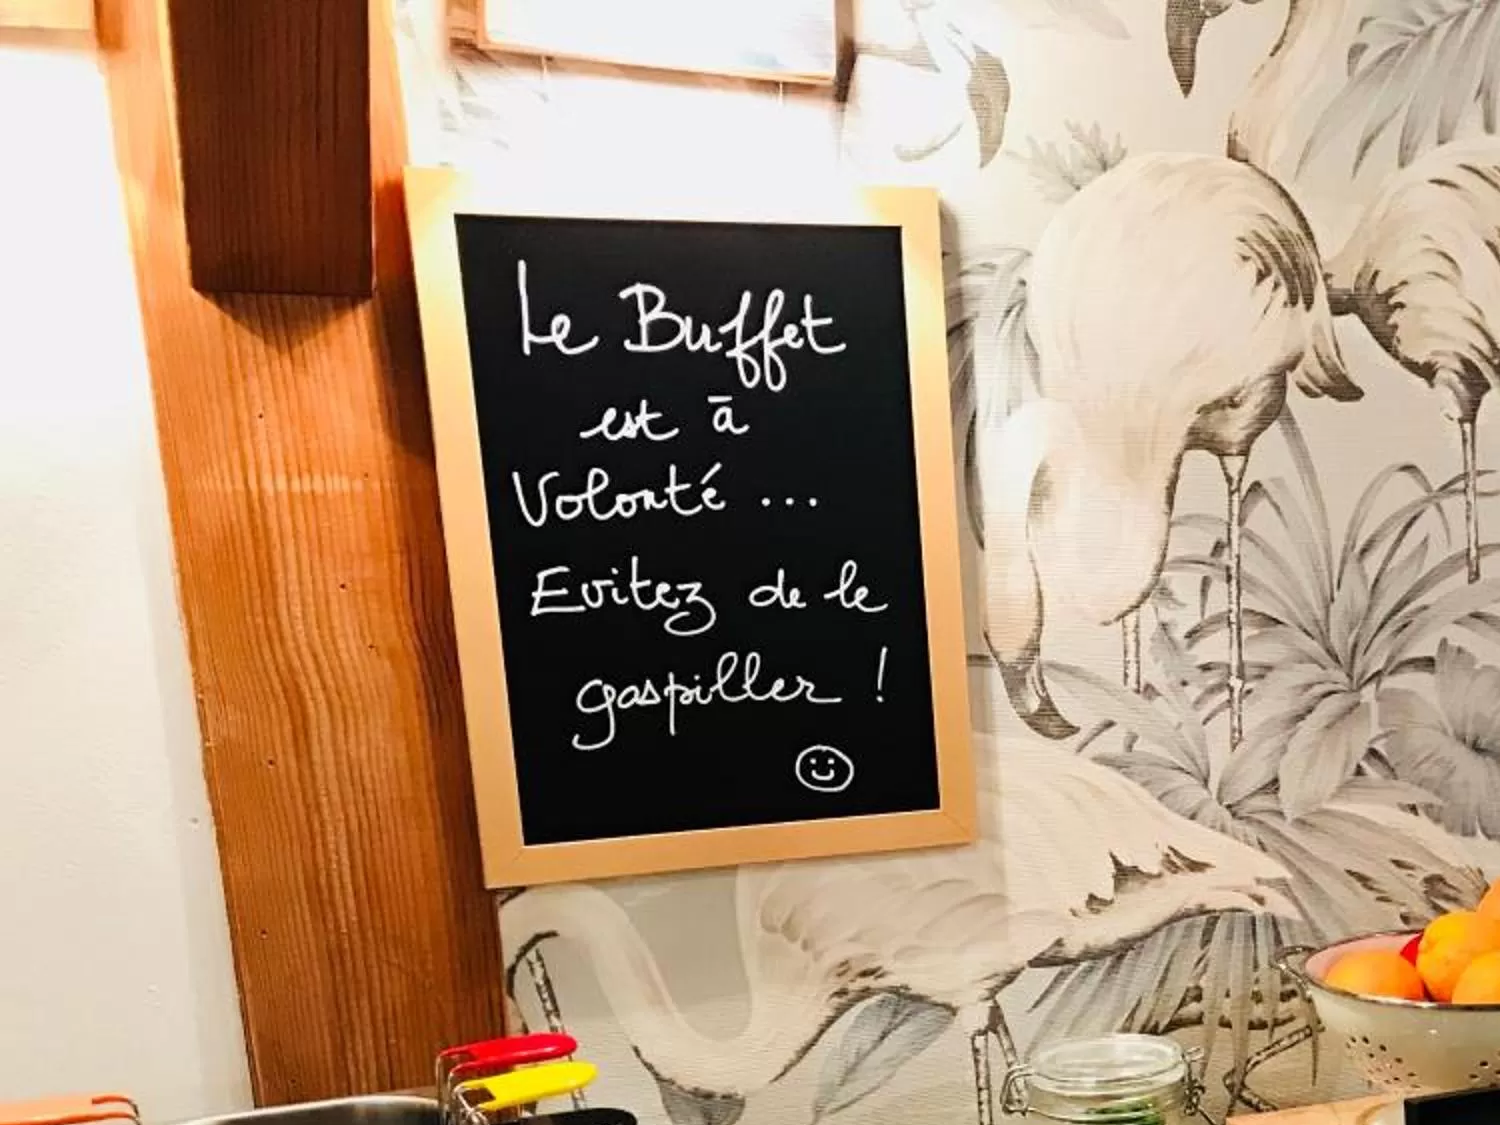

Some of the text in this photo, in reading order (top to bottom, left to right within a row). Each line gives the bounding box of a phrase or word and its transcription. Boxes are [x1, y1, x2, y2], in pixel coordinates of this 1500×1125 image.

[518, 259, 847, 391] Le Buffet
[580, 400, 680, 441] est
[512, 463, 727, 527] Volonté
[530, 556, 889, 635] Evitez de le
[572, 651, 842, 750] gaspiller
